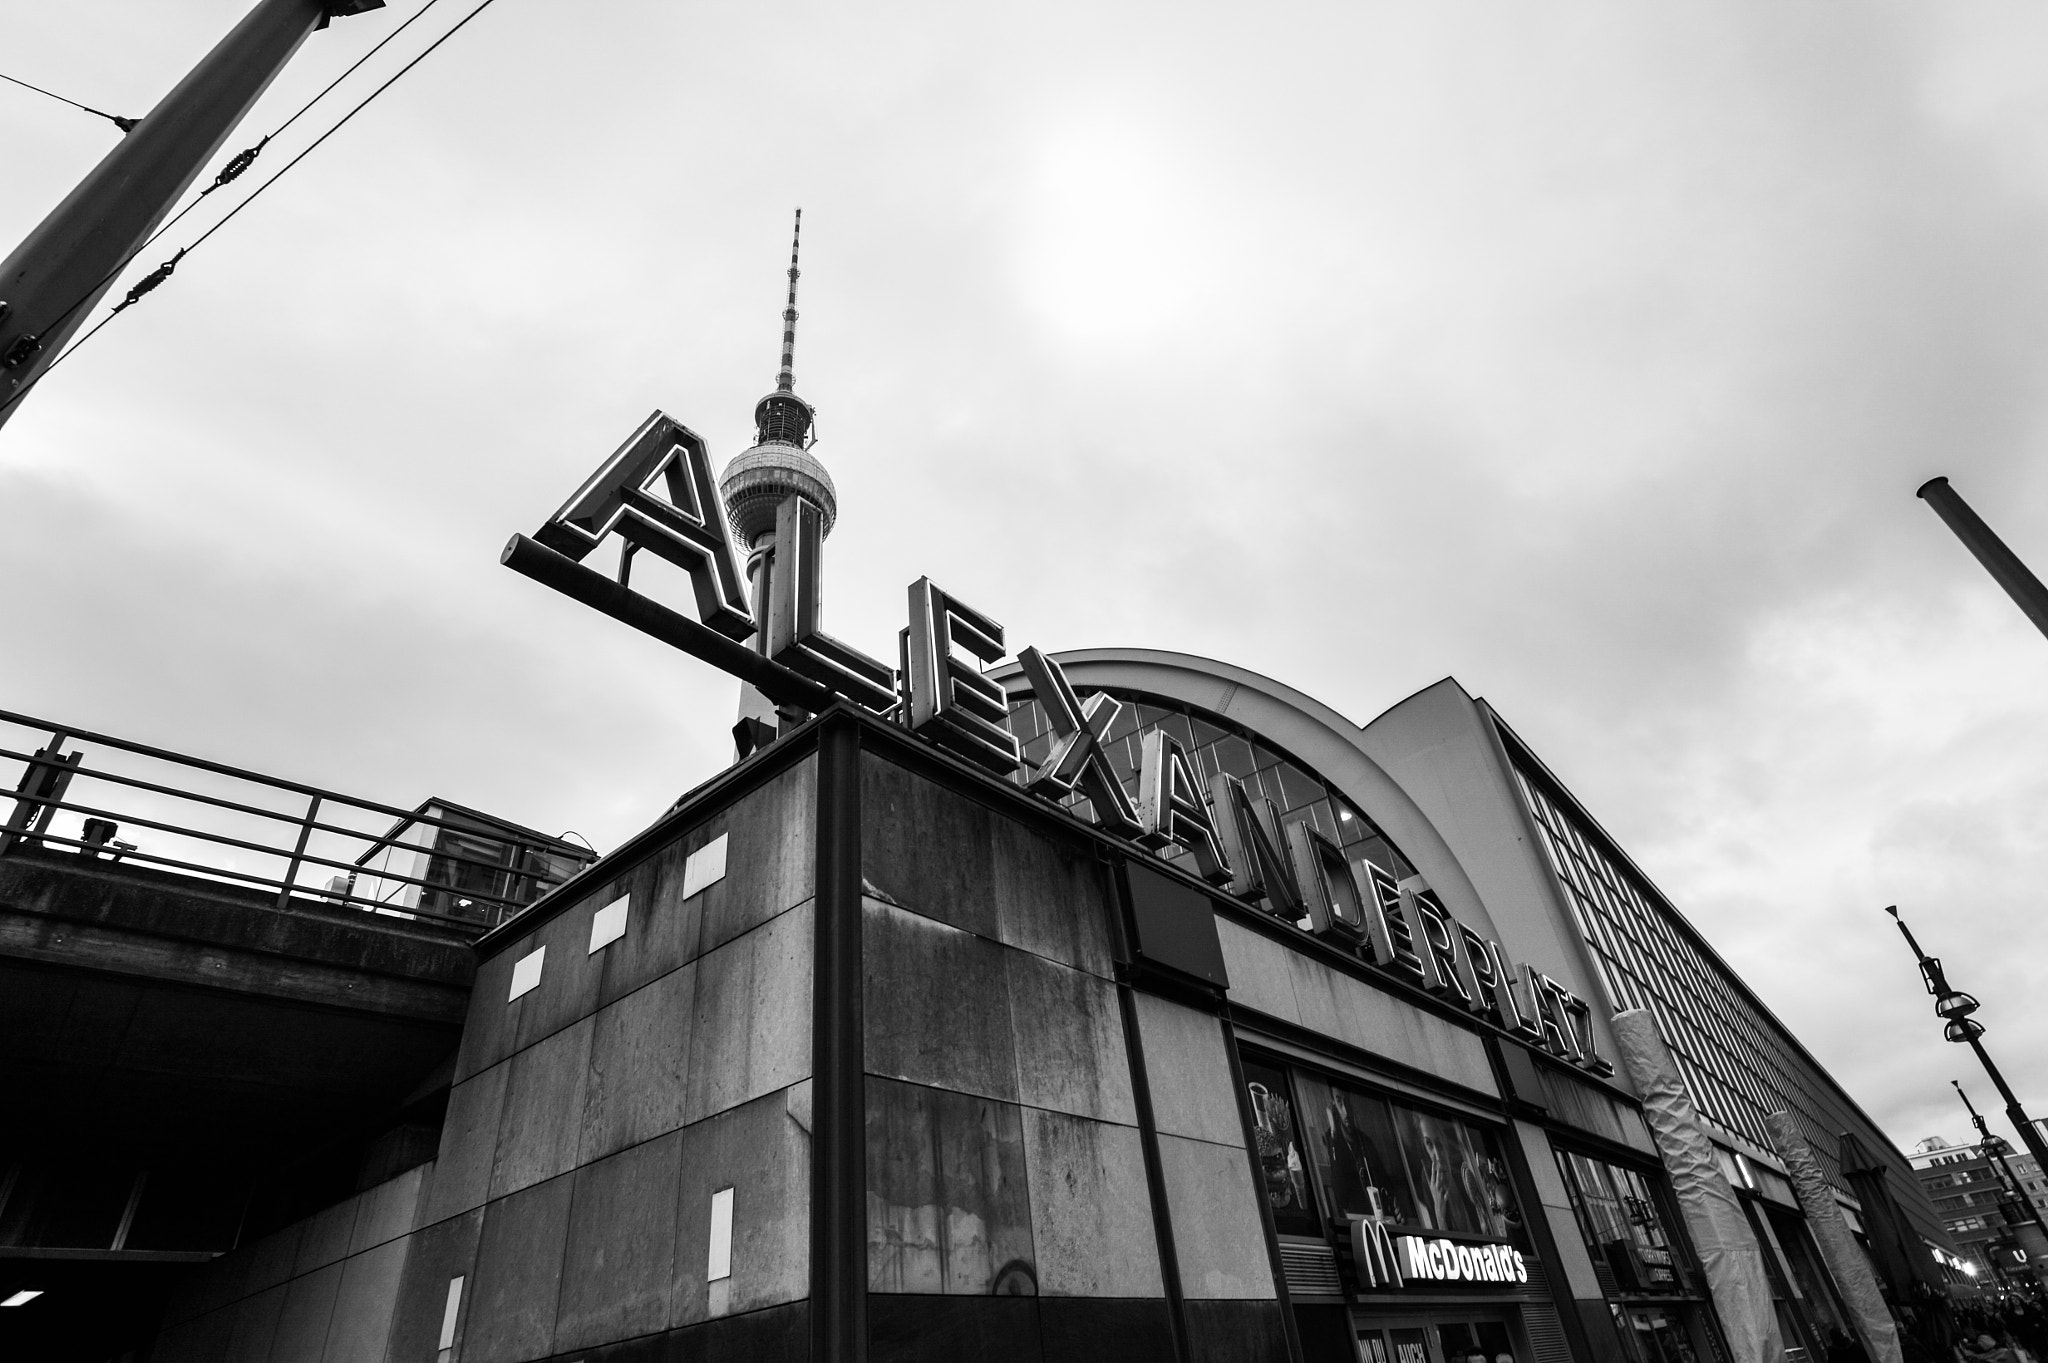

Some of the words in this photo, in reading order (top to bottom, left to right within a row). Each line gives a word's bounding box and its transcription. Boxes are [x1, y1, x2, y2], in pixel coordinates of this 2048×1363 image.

[532, 409, 1615, 1078] ALEXANDERPLATZ
[1405, 1235, 1528, 1284] McDonald's
[2012, 1249, 2028, 1263] U
[1397, 1342, 1427, 1363] AUCH
